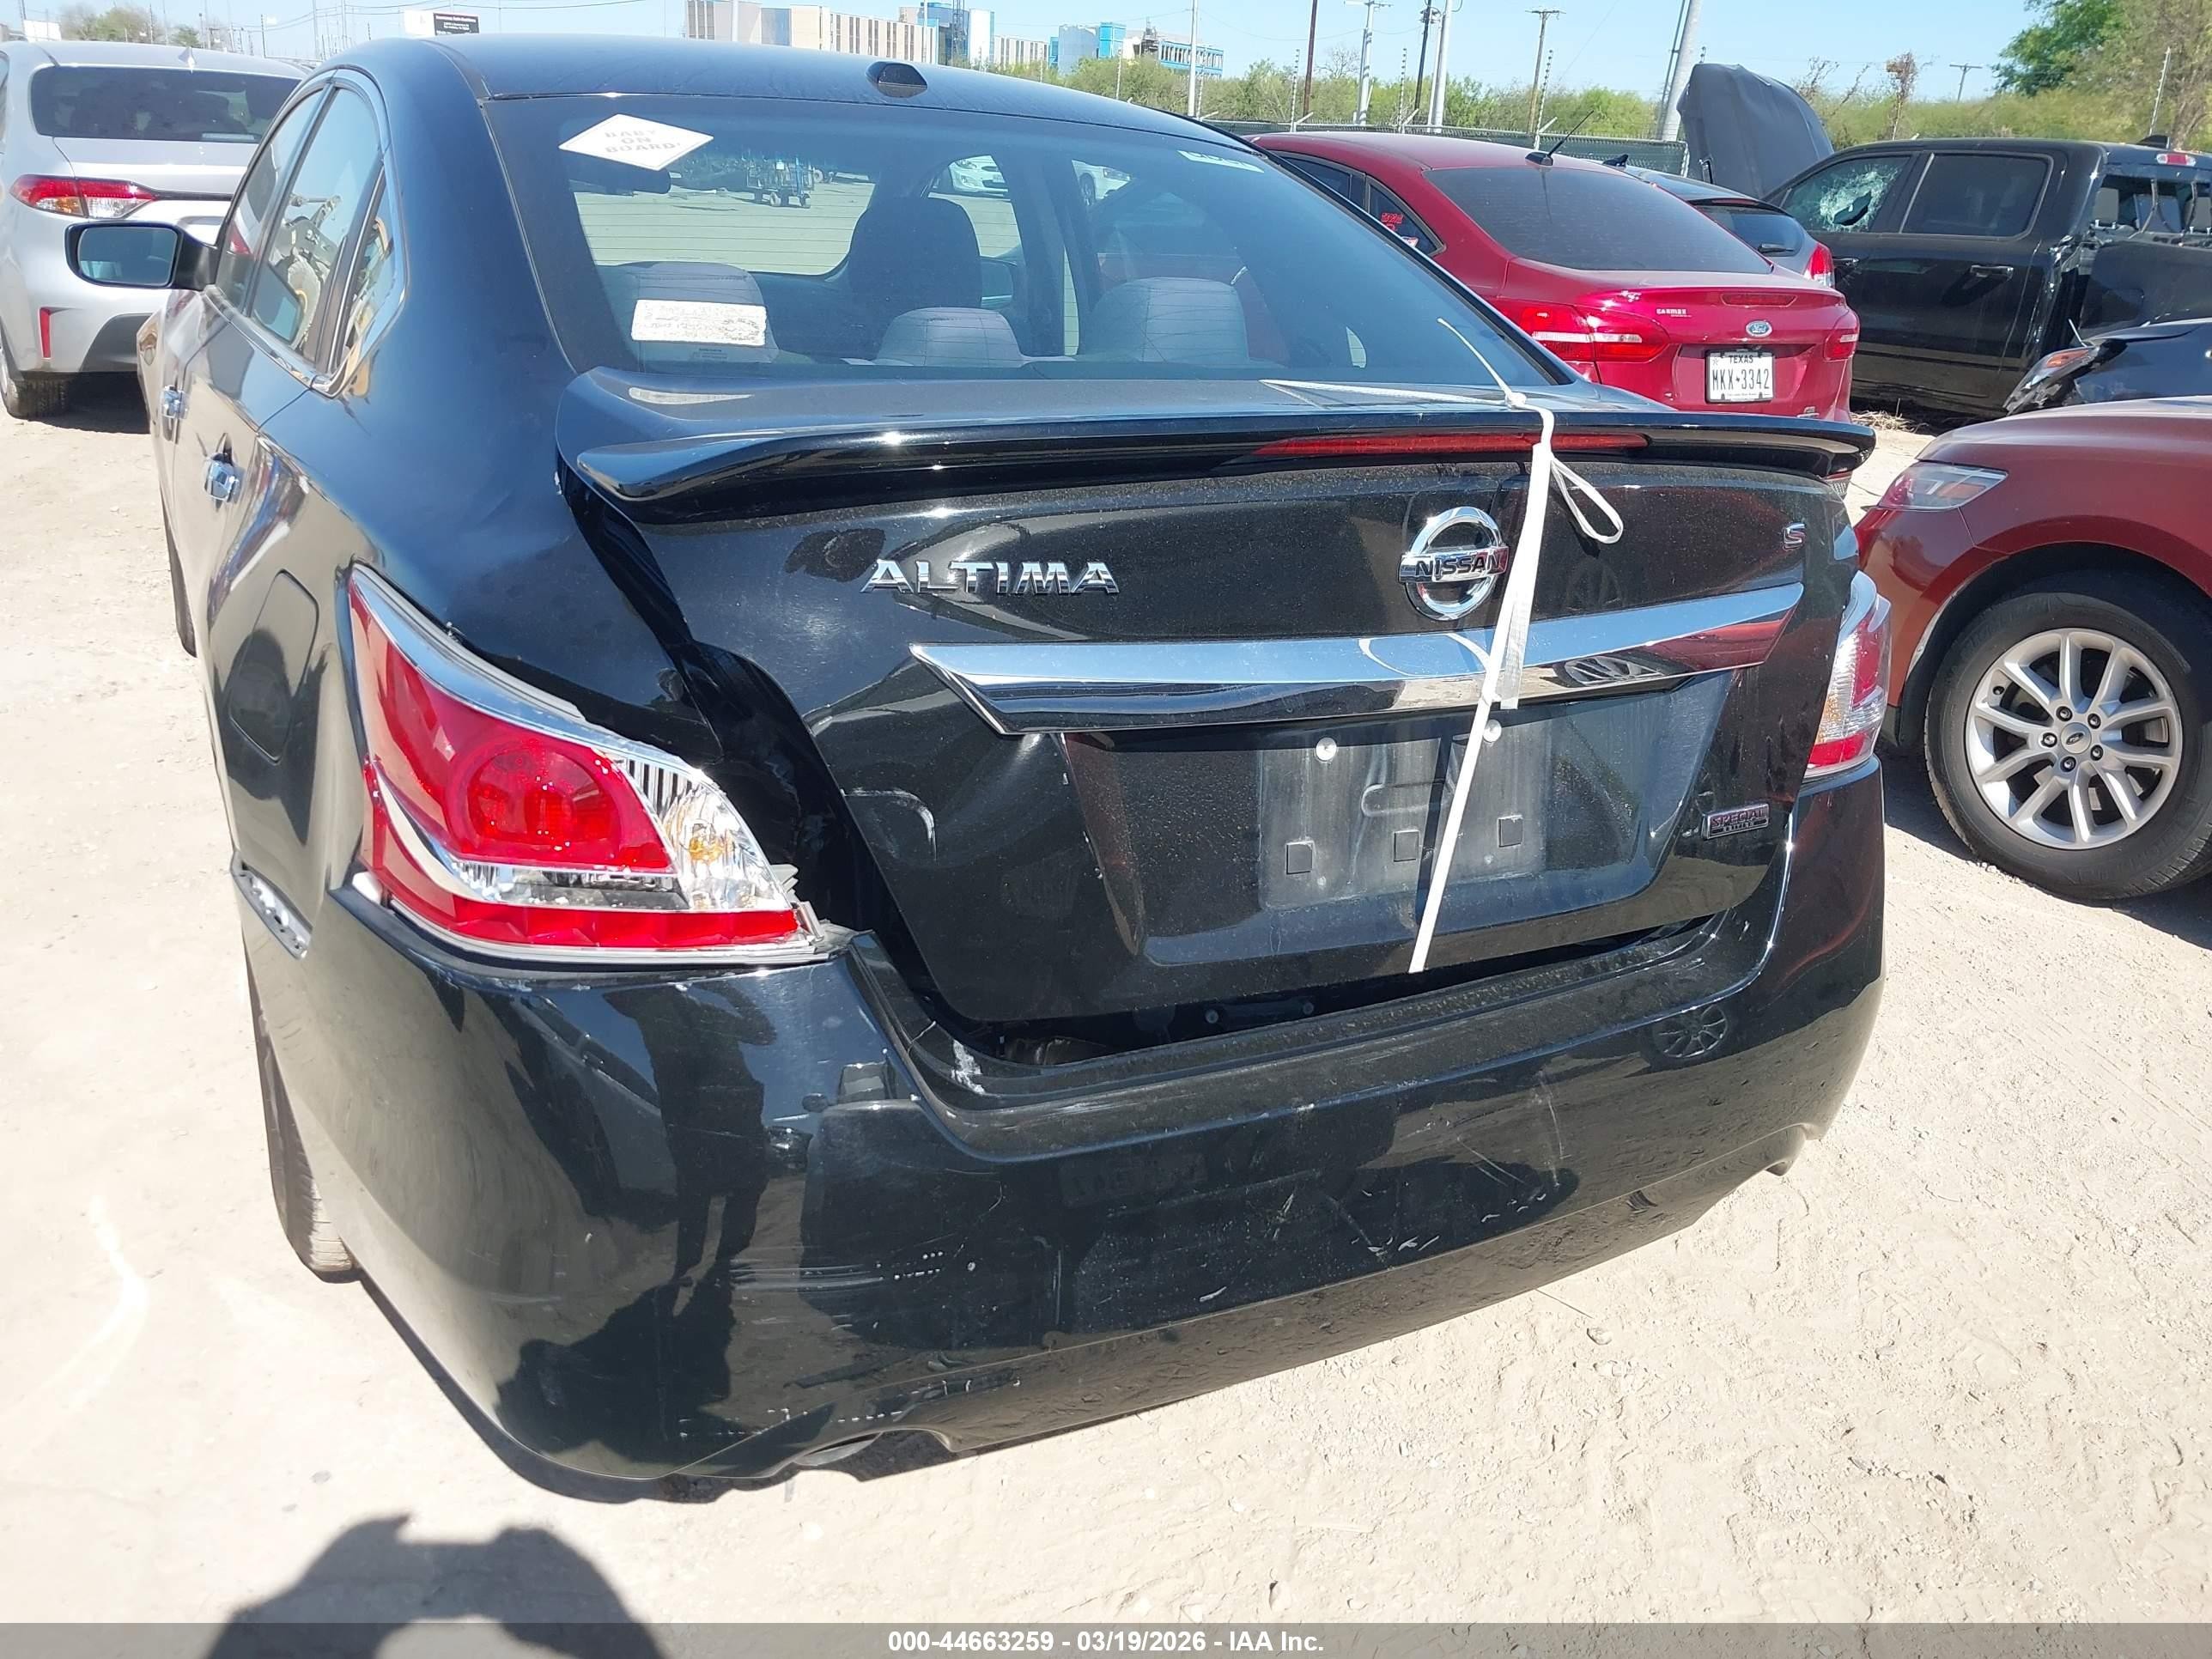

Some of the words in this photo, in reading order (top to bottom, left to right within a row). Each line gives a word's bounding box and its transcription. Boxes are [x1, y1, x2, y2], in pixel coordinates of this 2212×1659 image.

[1729, 355, 1753, 364] TEXAS
[1784, 522, 1807, 550] S
[860, 559, 1120, 594] ALTIMA
[1415, 553, 1501, 580] NISSAN
[1712, 809, 1766, 826] SPECIAL
